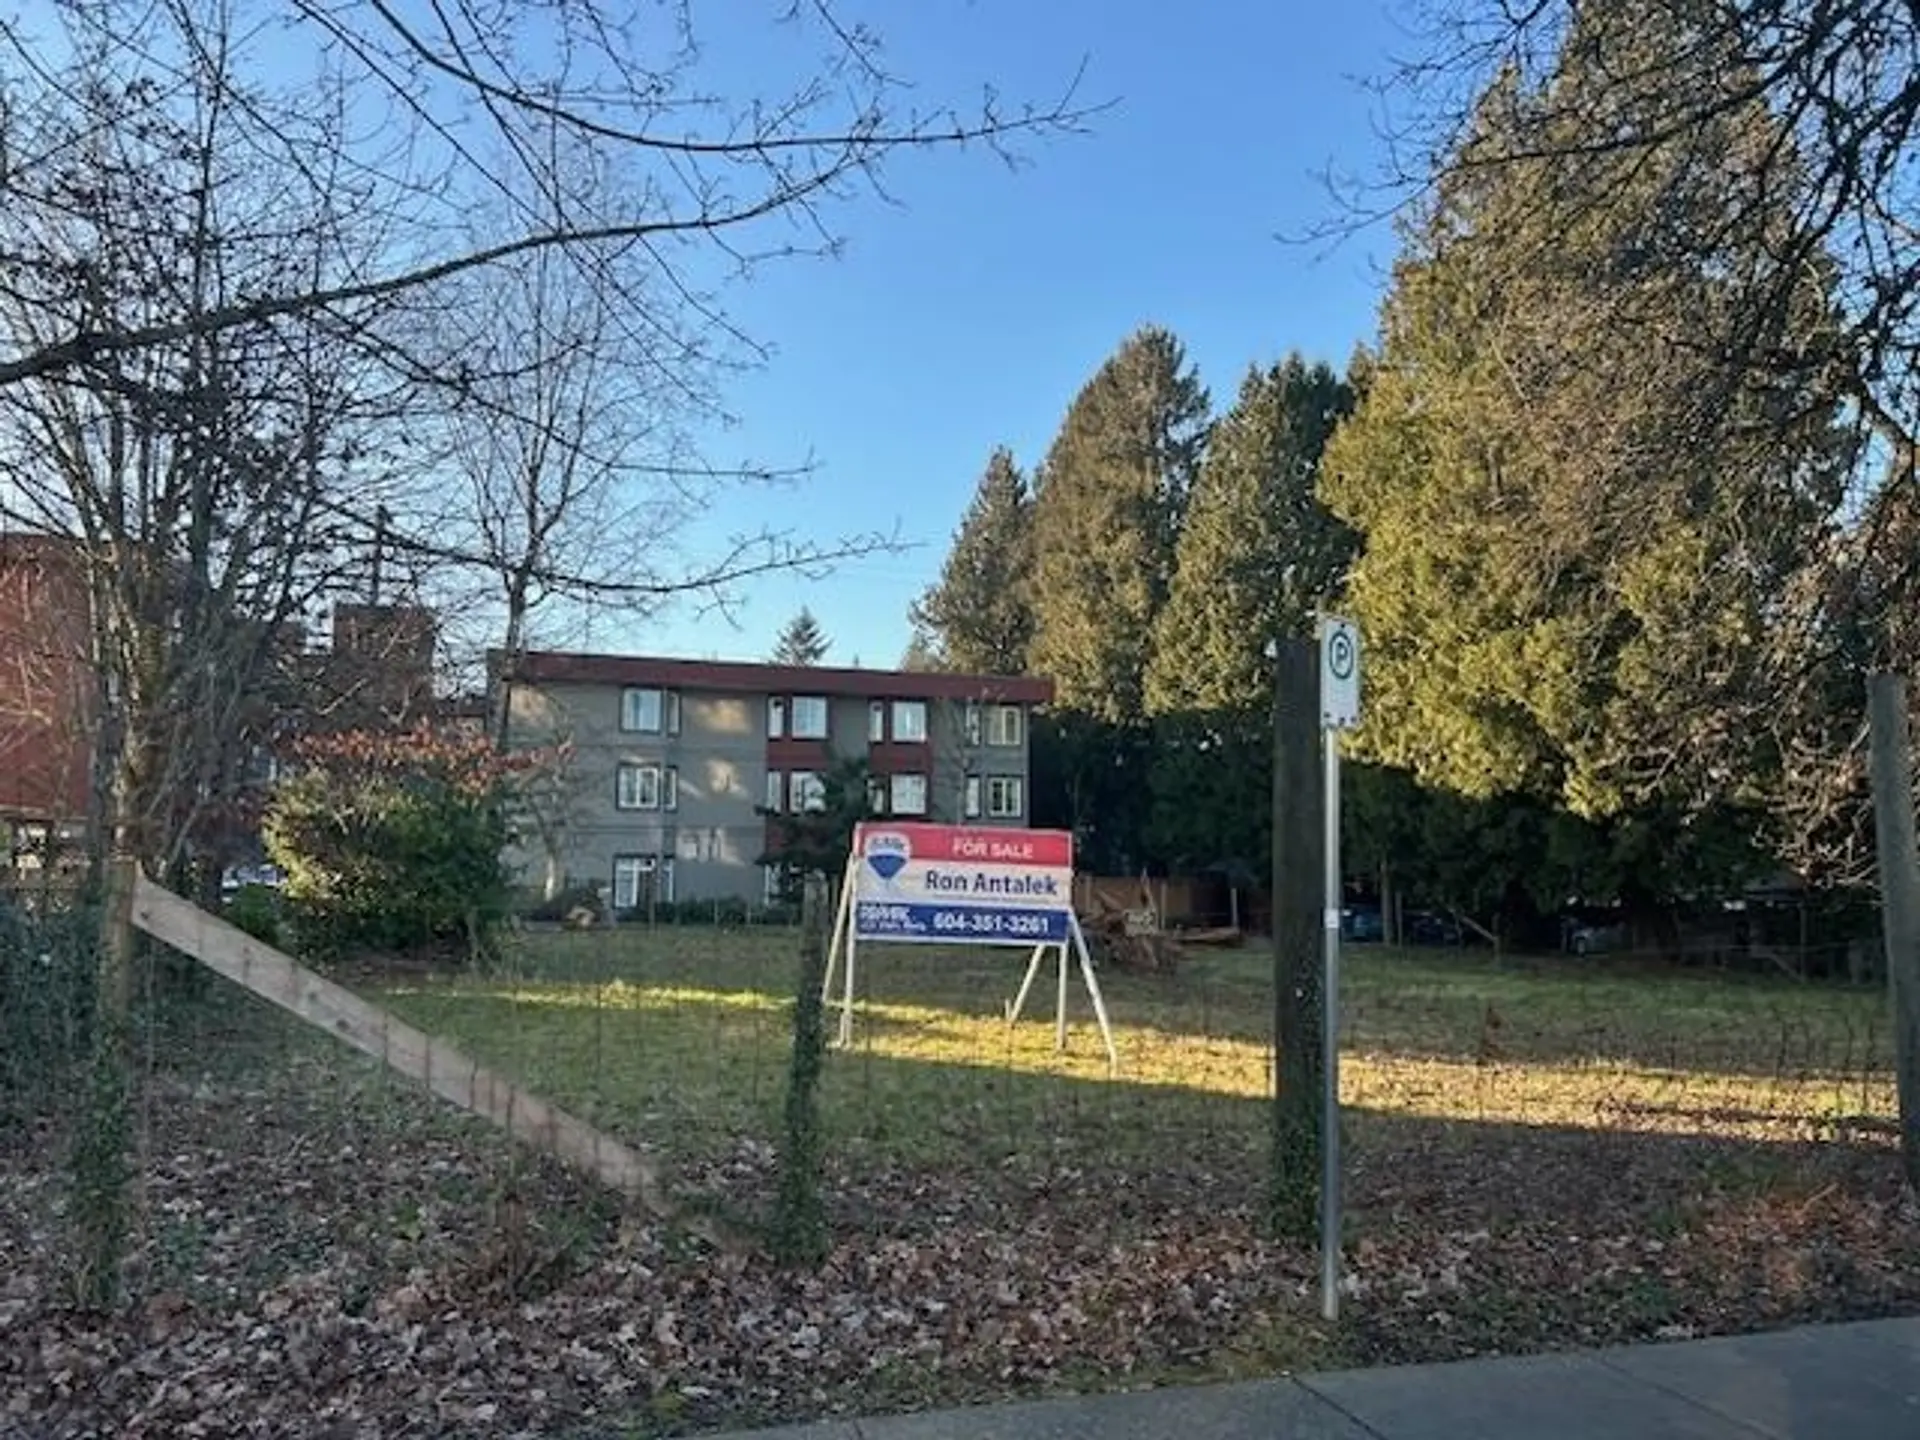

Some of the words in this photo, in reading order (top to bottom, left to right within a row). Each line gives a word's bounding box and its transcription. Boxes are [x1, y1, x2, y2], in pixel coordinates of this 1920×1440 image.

[952, 838, 988, 857] FOR
[990, 843, 1033, 859] SALE
[926, 870, 967, 890] Ron
[972, 872, 1057, 896] Antalek
